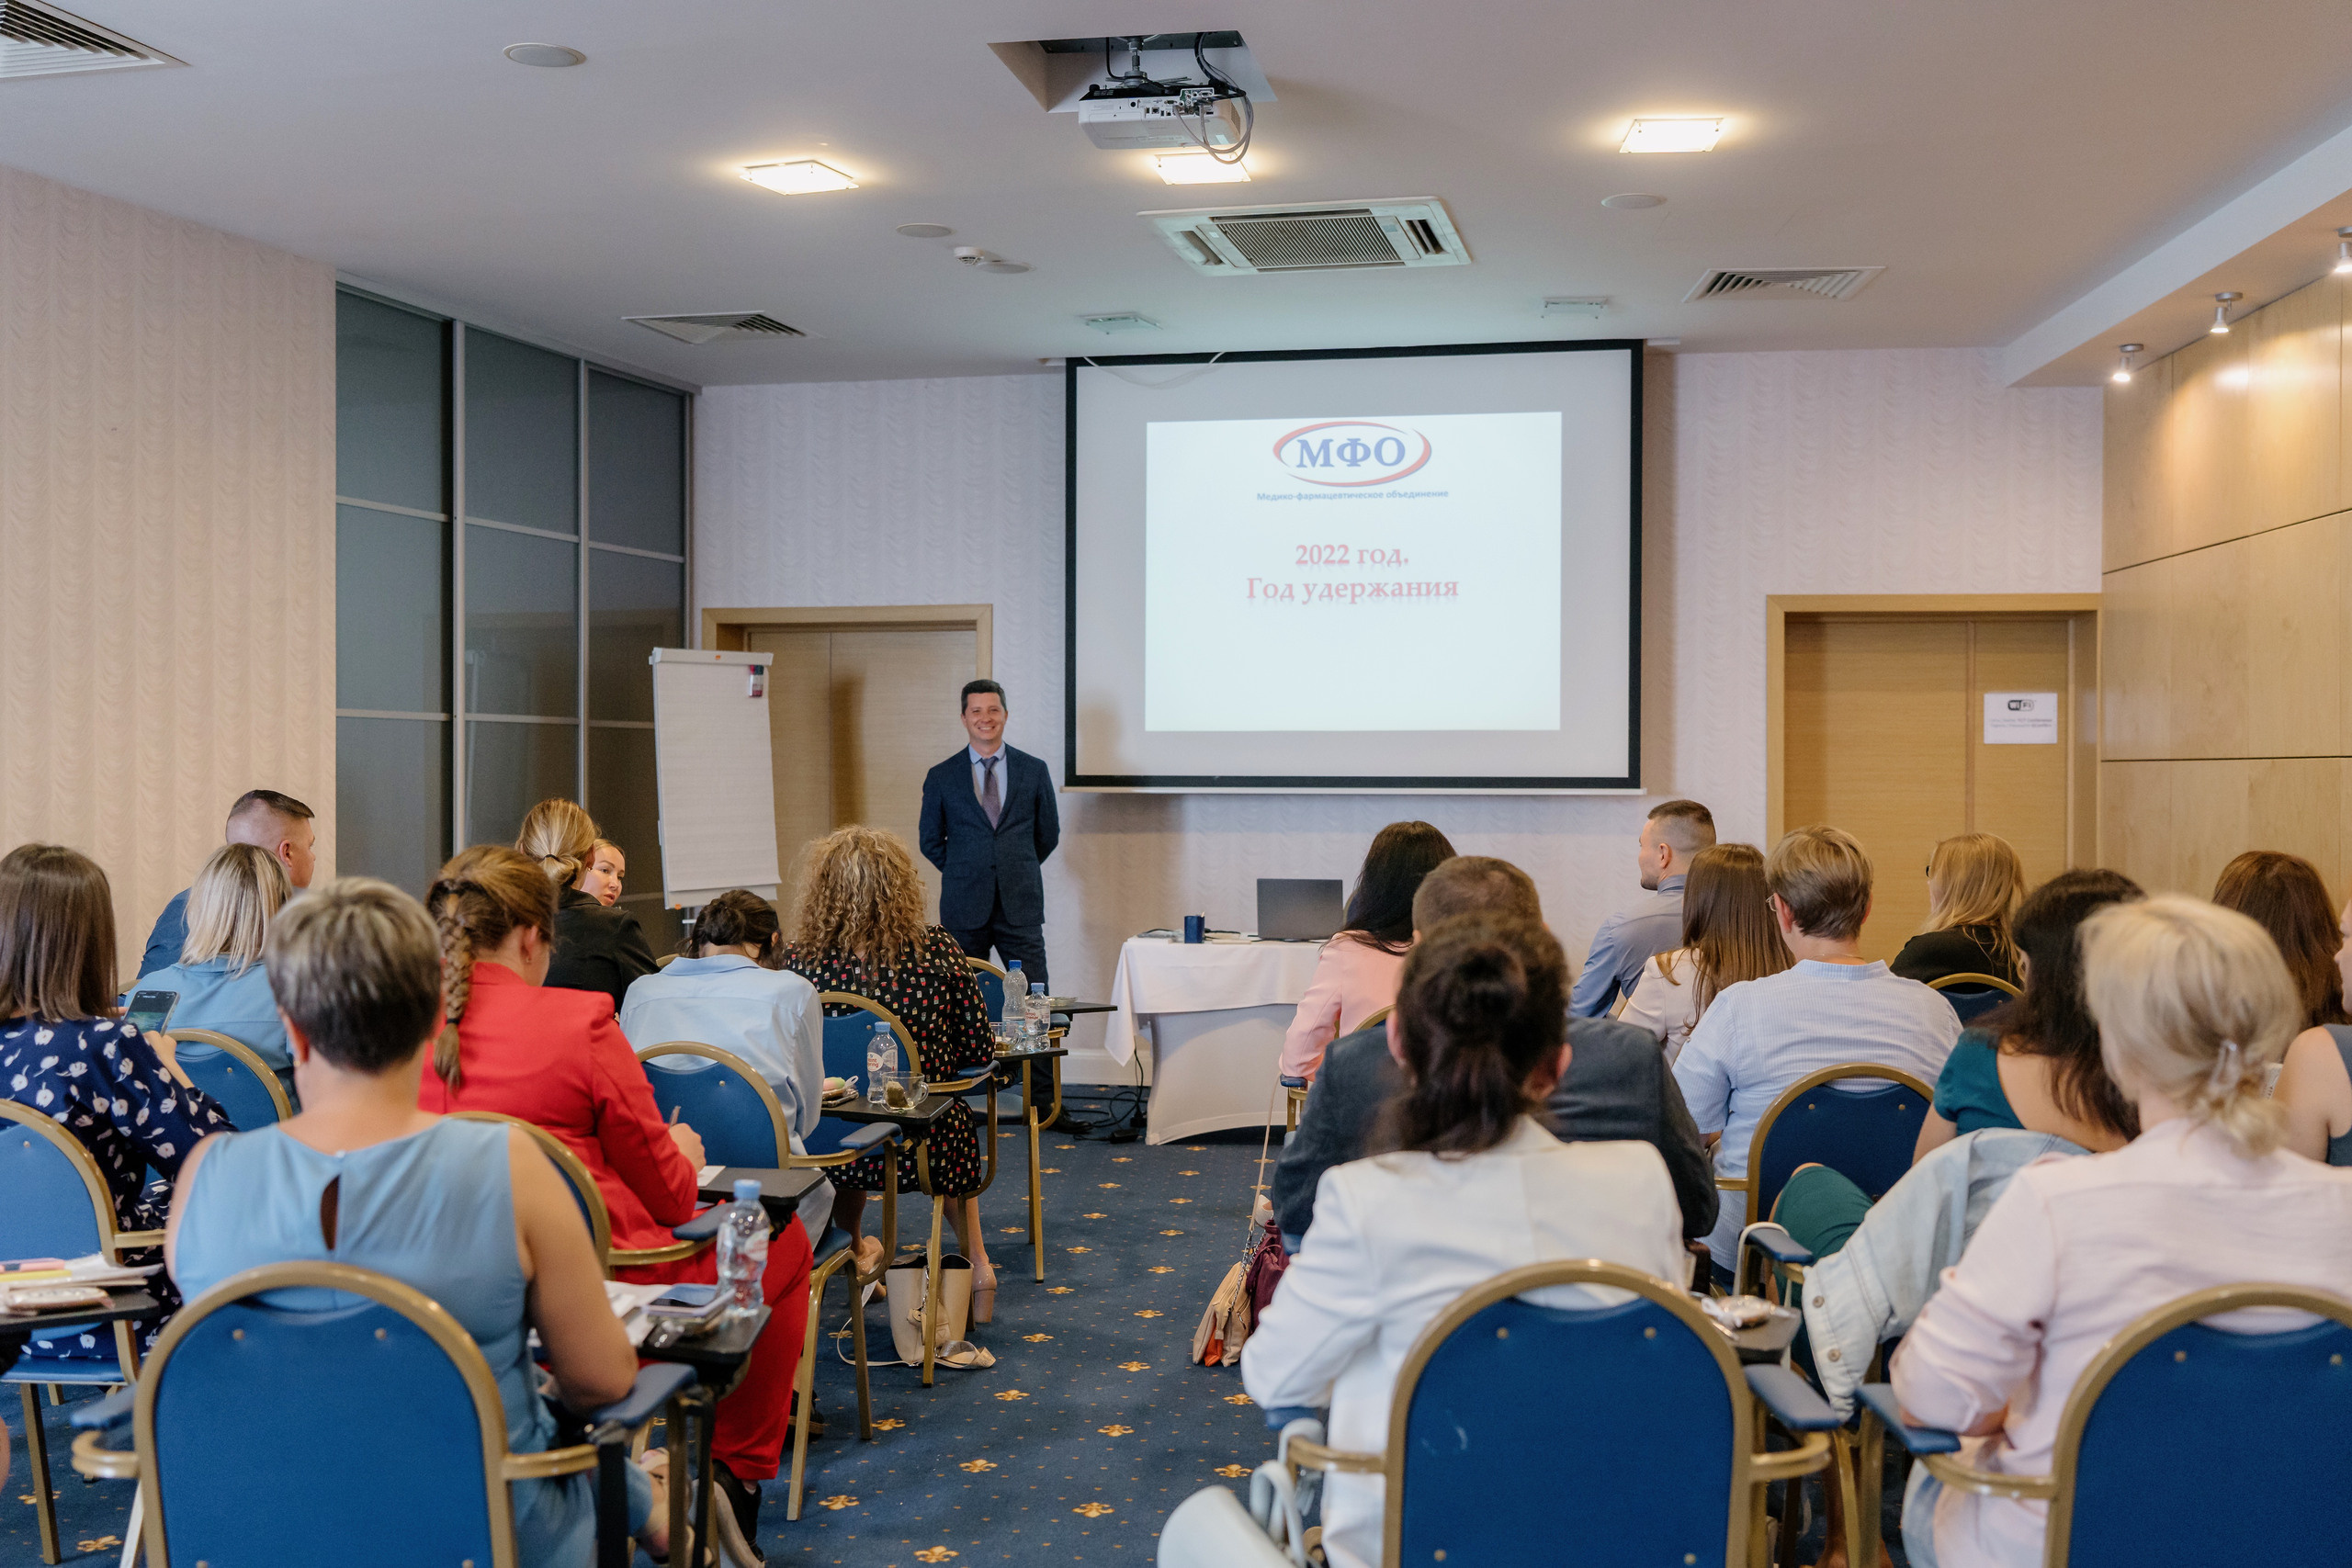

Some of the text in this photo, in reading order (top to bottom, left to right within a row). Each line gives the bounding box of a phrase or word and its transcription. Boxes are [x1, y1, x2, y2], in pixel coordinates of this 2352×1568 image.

[1295, 436, 1407, 468] МФО
[1256, 490, 1450, 502] Медико-фармацевтическое объединение
[1295, 544, 1409, 568] 2022 год.
[1246, 577, 1460, 605] Год удержания
